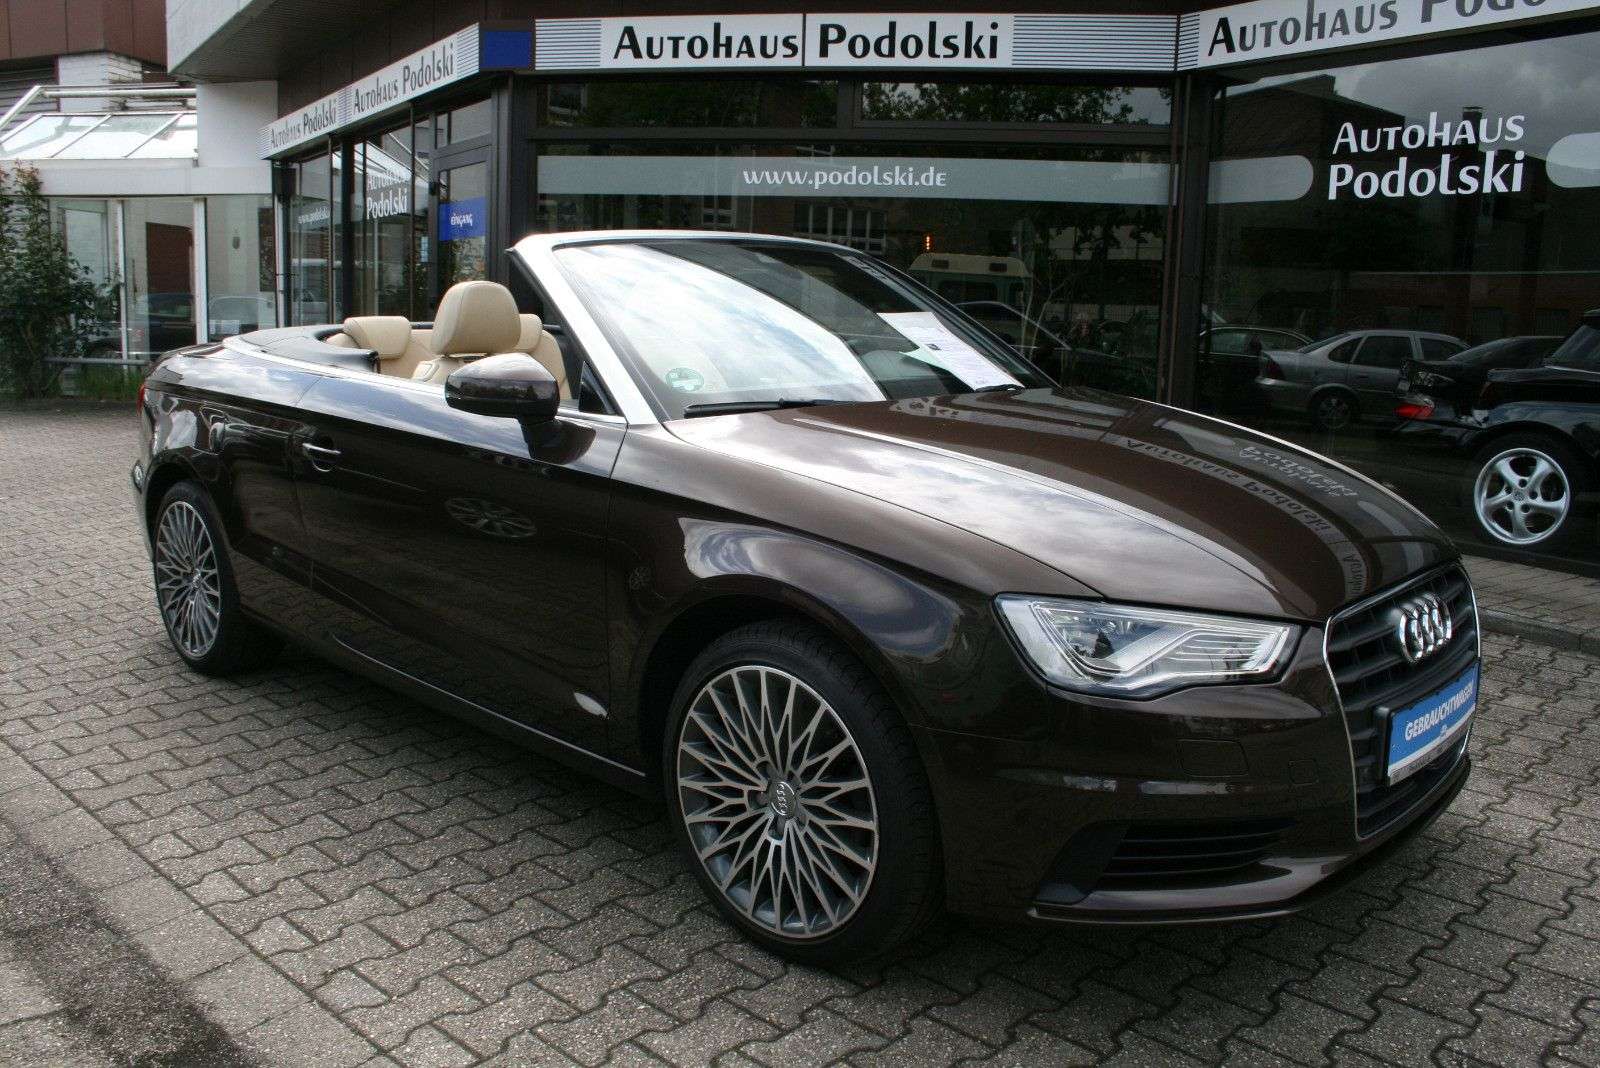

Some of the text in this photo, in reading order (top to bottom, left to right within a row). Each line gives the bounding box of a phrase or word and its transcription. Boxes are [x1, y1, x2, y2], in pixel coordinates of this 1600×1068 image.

[819, 20, 999, 59] Podolski
[402, 43, 453, 94] Podolski
[303, 98, 336, 136] Podolski
[743, 165, 947, 189] www.podolski.de
[1328, 150, 1525, 200] Podolski
[366, 187, 407, 220] Podolski
